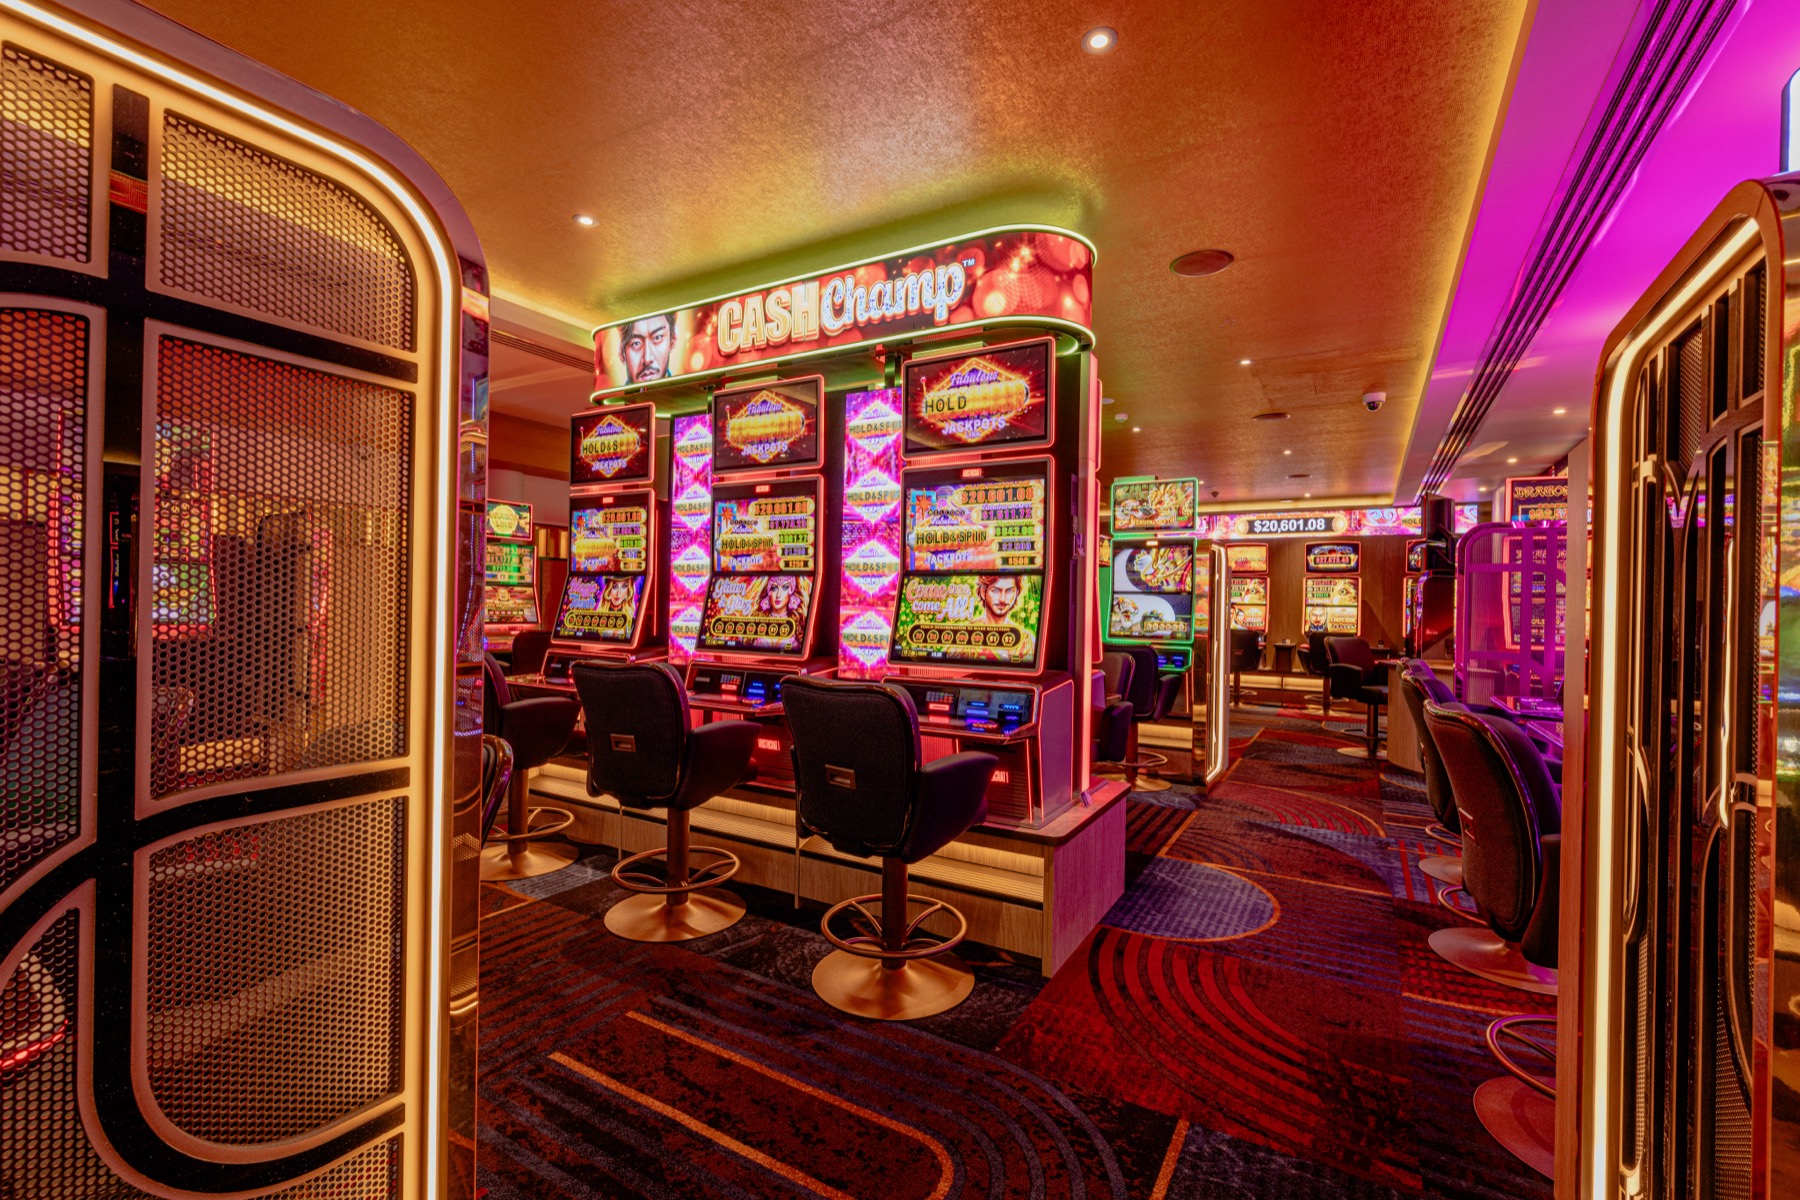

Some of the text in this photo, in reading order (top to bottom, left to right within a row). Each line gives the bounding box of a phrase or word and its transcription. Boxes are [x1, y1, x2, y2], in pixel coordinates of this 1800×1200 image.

[717, 281, 821, 356] CASH
[950, 370, 999, 386] Fabulous
[747, 402, 783, 415] Fabulous
[925, 396, 967, 415] HOLD
[942, 417, 1006, 435] JACKPOTS
[741, 441, 788, 456] JACKPOTS
[591, 459, 627, 472] JACKPOTS
[1254, 518, 1325, 533] $20,601.08
